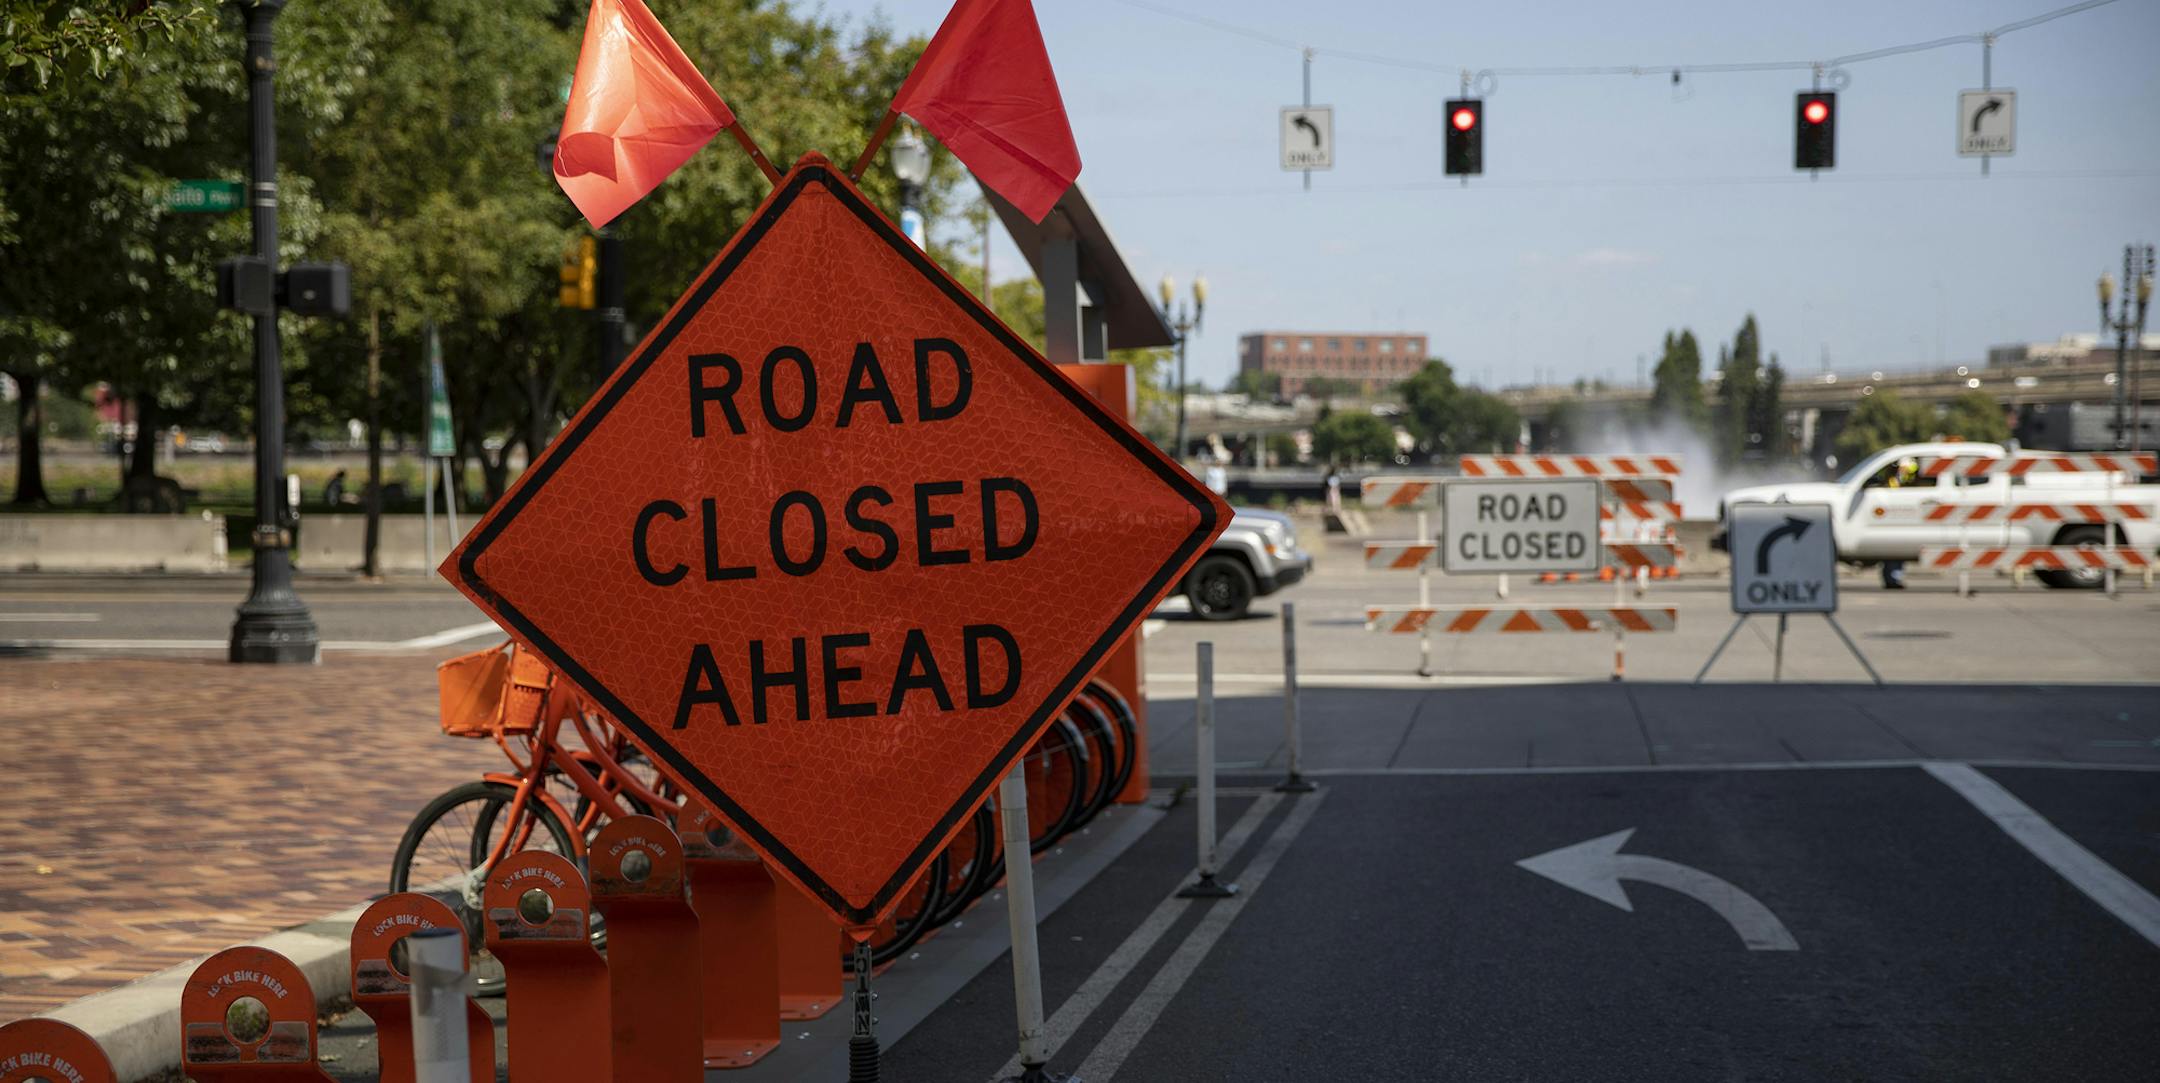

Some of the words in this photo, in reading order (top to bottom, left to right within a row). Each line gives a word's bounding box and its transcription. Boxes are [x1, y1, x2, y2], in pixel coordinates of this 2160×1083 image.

[688, 338, 973, 438] ROAD
[1478, 493, 1567, 522] ROAD
[633, 477, 1039, 586] CLOSED
[1459, 531, 1586, 560] CLOSED
[1747, 580, 1822, 605] ONLY
[672, 624, 1022, 730] AHEAD
[396, 915, 420, 925] BIKE
[233, 970, 261, 983] BIKE
[260, 974, 288, 999] HERE
[20, 1052, 52, 1067] BIKE
